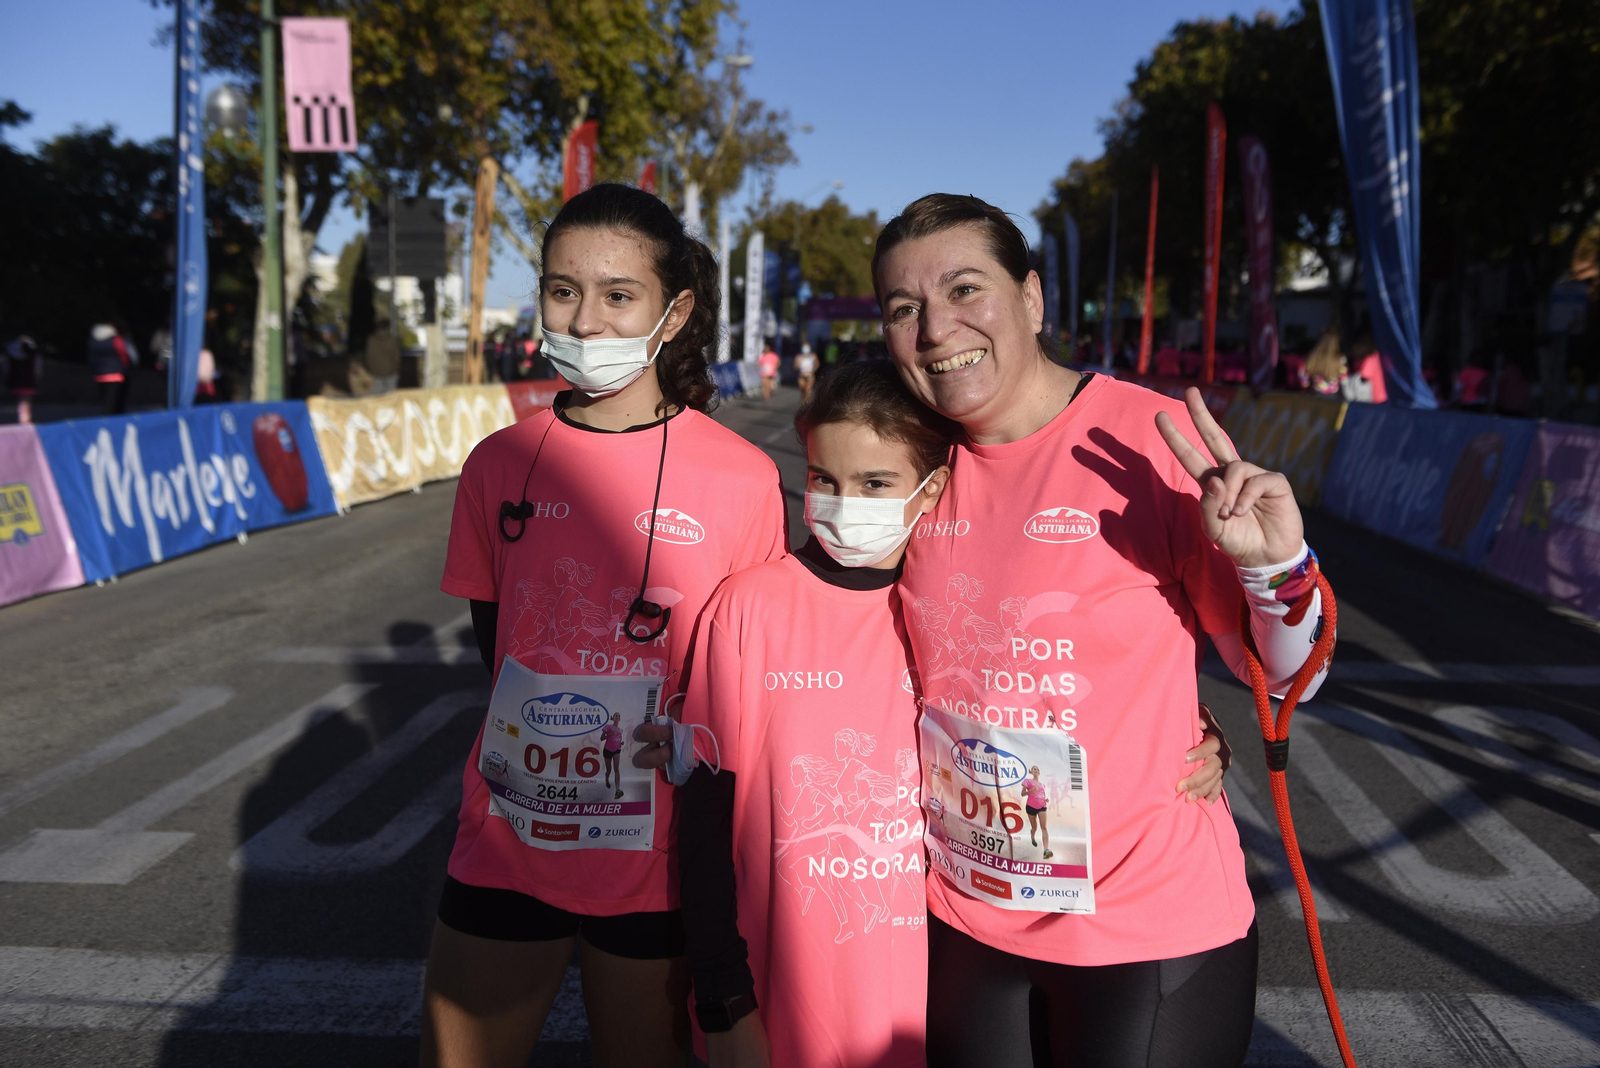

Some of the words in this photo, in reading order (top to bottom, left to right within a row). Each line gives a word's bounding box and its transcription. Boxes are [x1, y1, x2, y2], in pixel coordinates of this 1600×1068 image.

[916, 519, 970, 539] OYSHO
[1028, 519, 1092, 535] ASTURIANA
[1011, 637, 1074, 661] POR
[577, 649, 662, 677] TODAS
[764, 670, 843, 691] OYSHO
[981, 669, 1075, 696] TODAS
[526, 705, 602, 726] ASTURIANA
[940, 698, 1077, 731] NOSOTRAS
[524, 743, 600, 778] 016
[504, 789, 544, 812] CARRERA
[547, 803, 563, 814] DE
[565, 806, 580, 815] LA
[582, 804, 622, 815] MUJER
[536, 783, 578, 801] 2644
[960, 787, 1024, 834] 016
[544, 828, 574, 836] Santander
[604, 828, 641, 837] ZURICH
[970, 831, 1005, 854] 3597
[980, 854, 993, 868] DE
[995, 859, 1009, 871] LA
[1011, 862, 1053, 875] MUJER
[981, 879, 1006, 893] Santander
[1039, 889, 1079, 898] ZURICH
